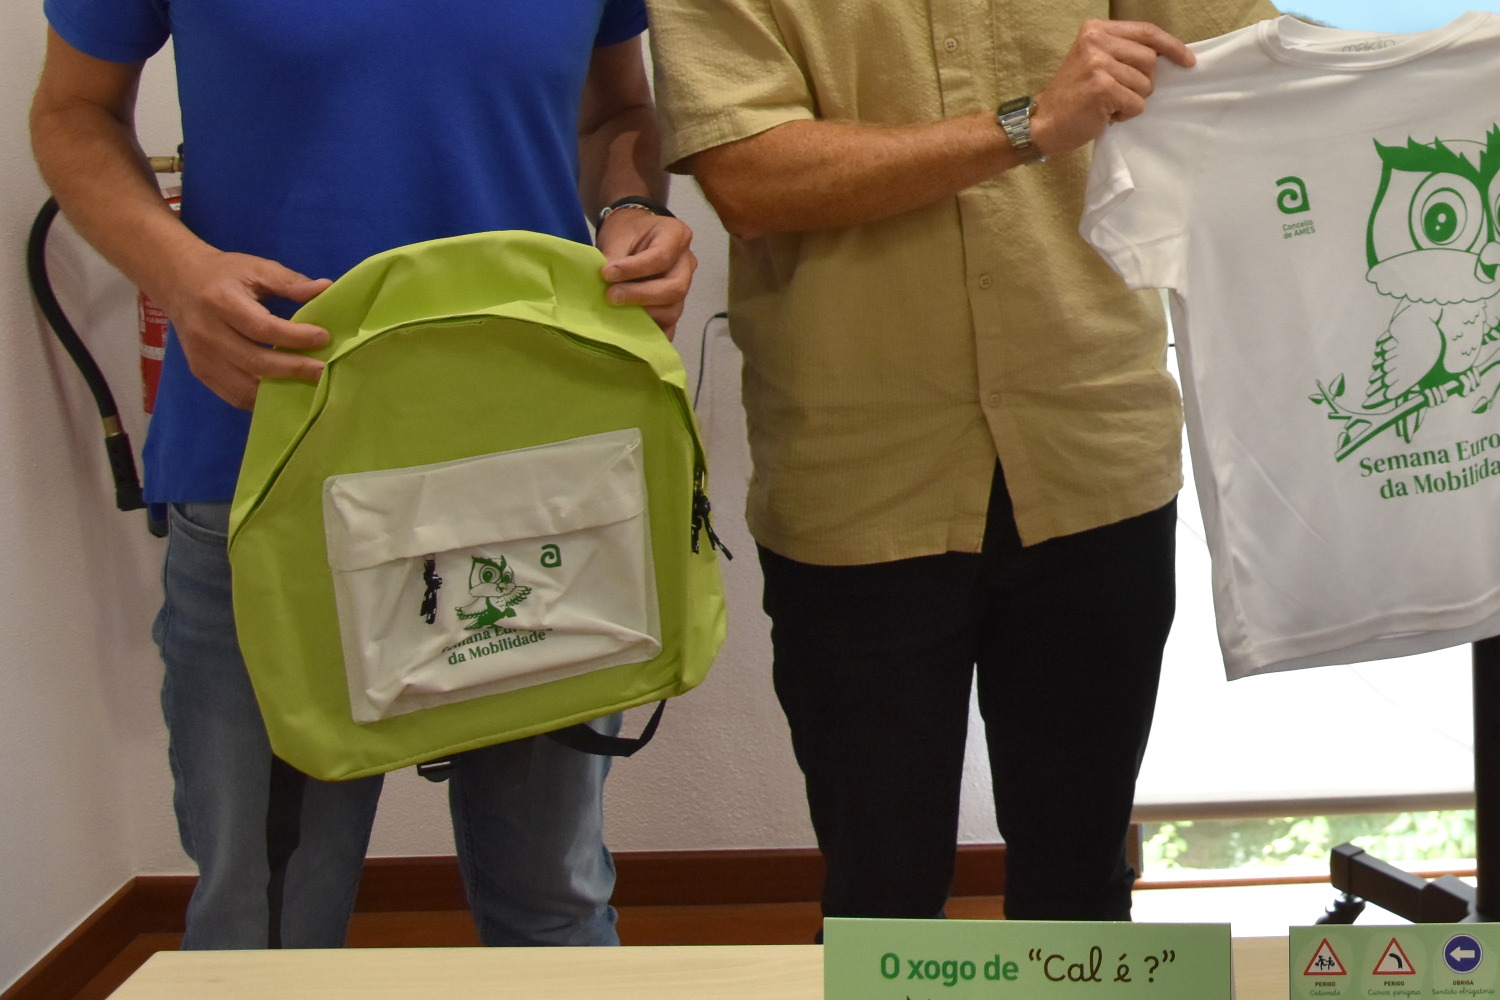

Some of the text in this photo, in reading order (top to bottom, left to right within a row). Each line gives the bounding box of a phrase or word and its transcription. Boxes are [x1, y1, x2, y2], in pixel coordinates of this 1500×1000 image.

[1282, 220, 1314, 231] Concello
[1294, 225, 1316, 237] AMES
[1359, 447, 1450, 478] Semana
[1379, 477, 1408, 500] da
[448, 652, 466, 665] da
[468, 629, 546, 660] Mobilidade
[880, 952, 900, 980] O
[907, 956, 977, 987] xogo
[983, 954, 1019, 981] de
[1113, 952, 1132, 983] é
[1431, 987, 1457, 995] Sentido
